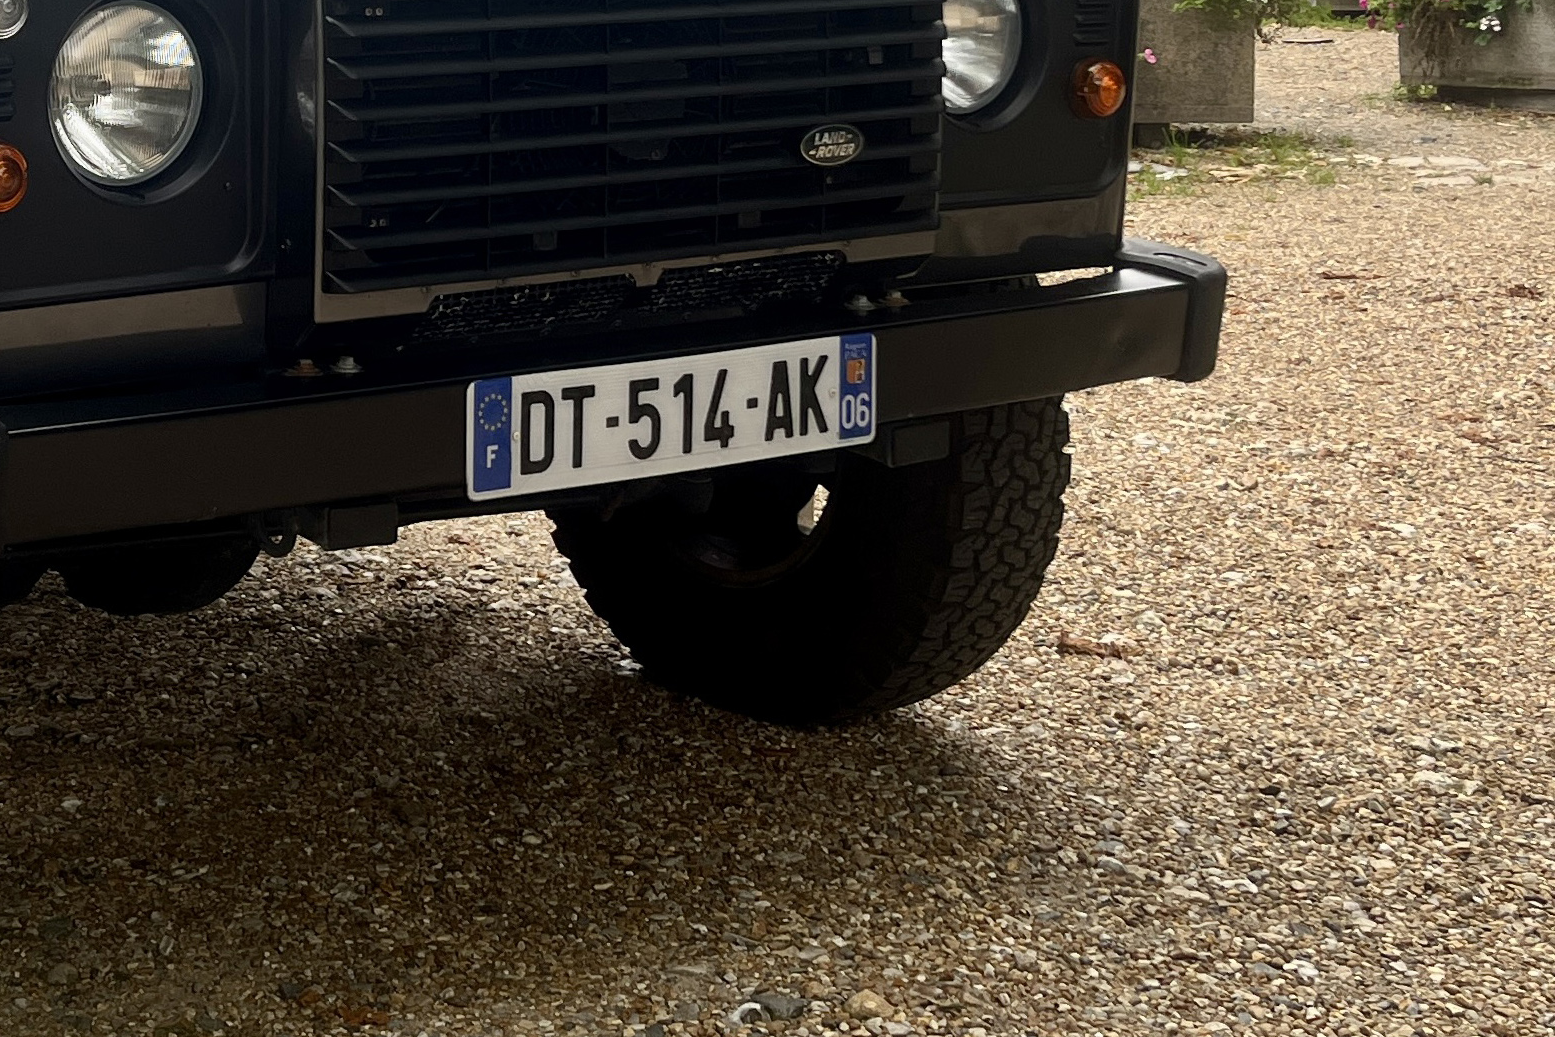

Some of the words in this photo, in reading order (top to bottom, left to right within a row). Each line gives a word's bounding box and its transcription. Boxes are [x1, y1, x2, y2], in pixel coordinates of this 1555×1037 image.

[520, 353, 829, 476] DT-514-AK
[841, 391, 870, 430] 06
[485, 444, 500, 469] F
